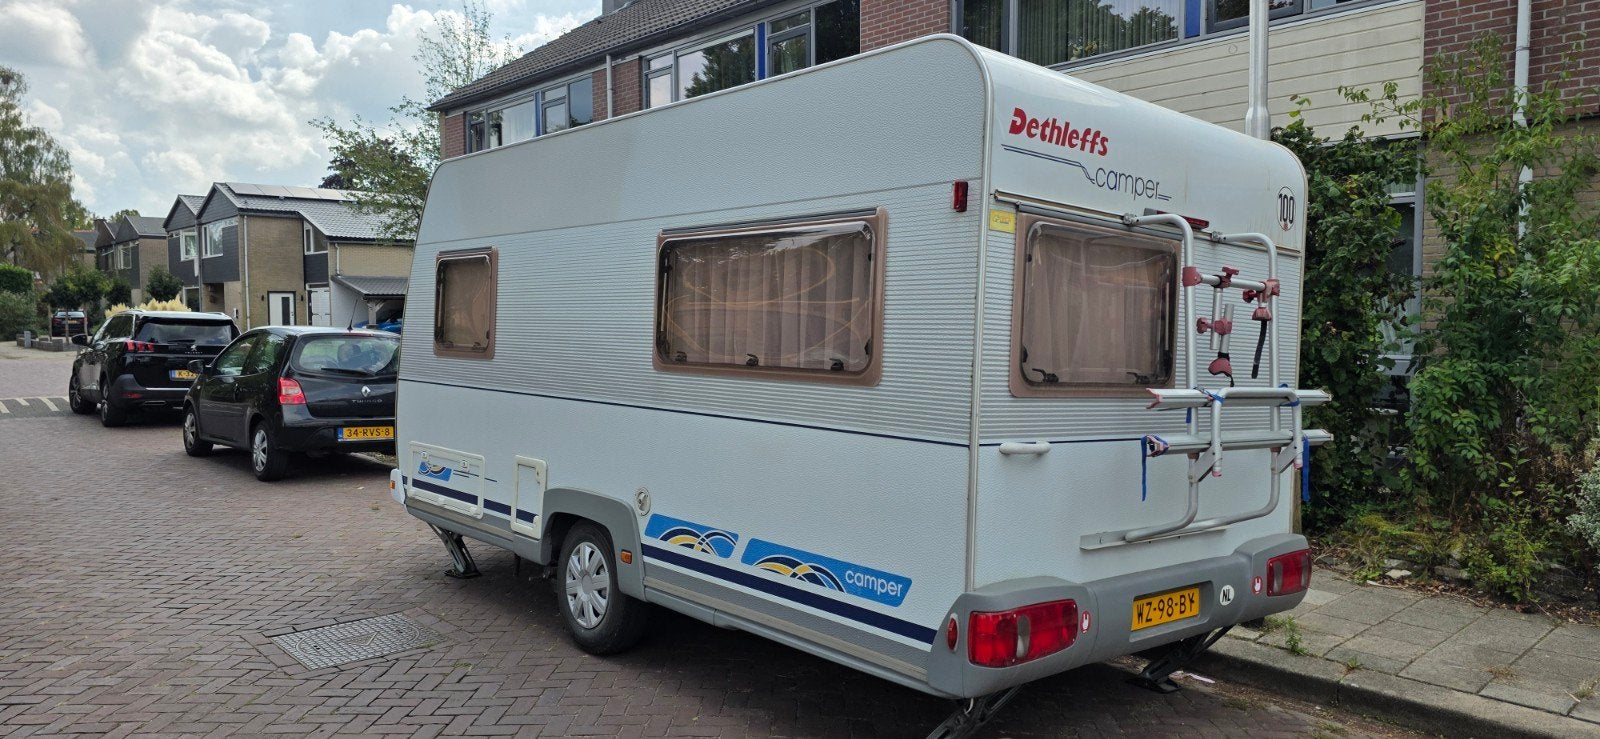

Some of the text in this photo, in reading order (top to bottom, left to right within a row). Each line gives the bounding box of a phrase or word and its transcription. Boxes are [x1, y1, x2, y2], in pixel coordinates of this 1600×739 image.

[1009, 107, 1109, 156] Dethleffs
[1095, 167, 1160, 200] camper
[1279, 193, 1295, 224] 100
[346, 427, 390, 438] 34-RVS-8
[845, 570, 903, 597] camper
[1222, 588, 1232, 603] NL
[1136, 592, 1195, 624] WZ-98-BY
